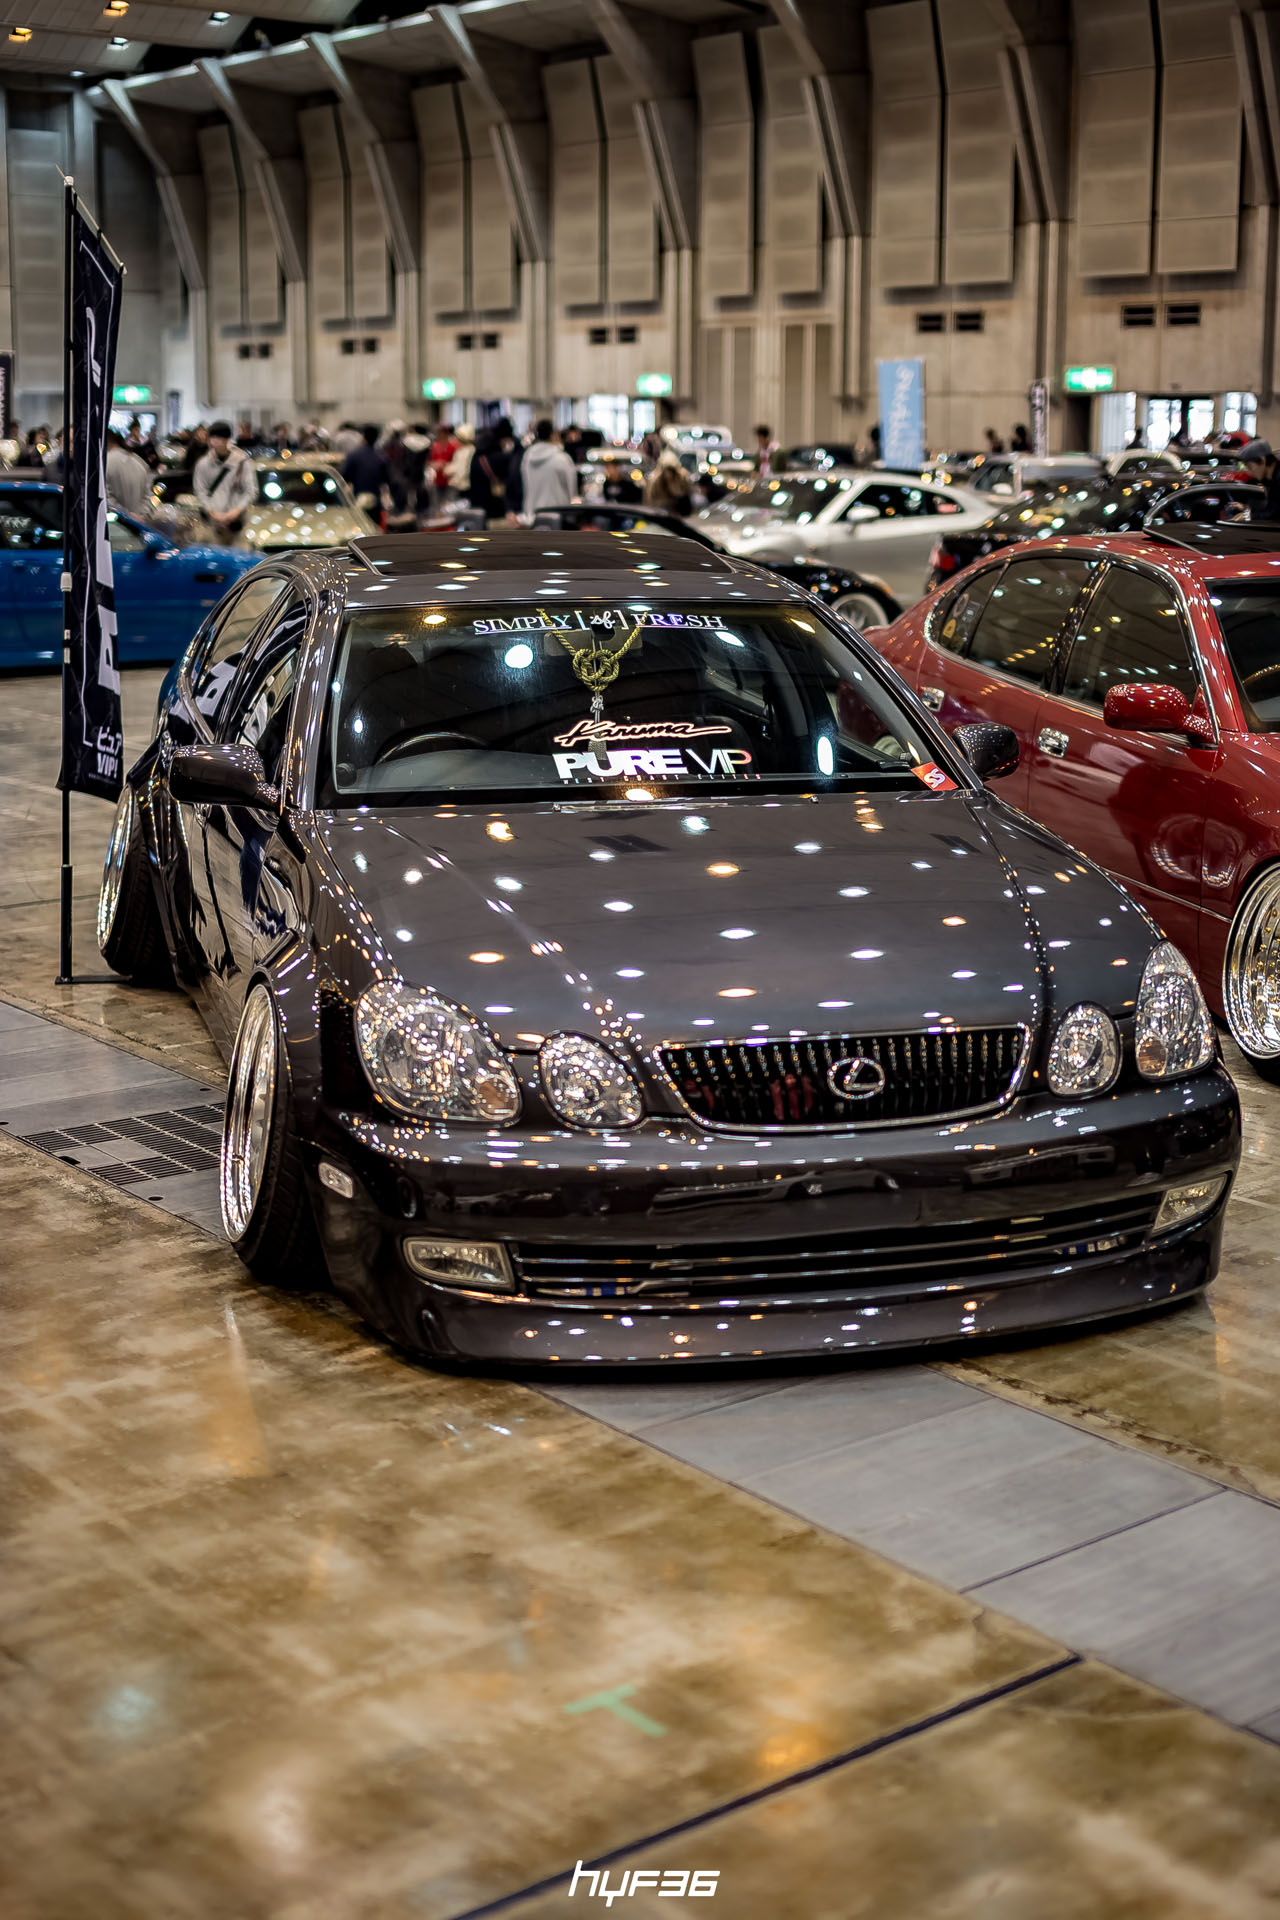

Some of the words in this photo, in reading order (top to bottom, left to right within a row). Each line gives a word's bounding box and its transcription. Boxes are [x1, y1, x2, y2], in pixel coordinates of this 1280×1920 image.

[472, 614, 572, 634] SIMPLY
[630, 613, 728, 630] FRESH
[97, 752, 119, 779] VIP!
[552, 748, 689, 779] PURE
[685, 748, 752, 774] VIP
